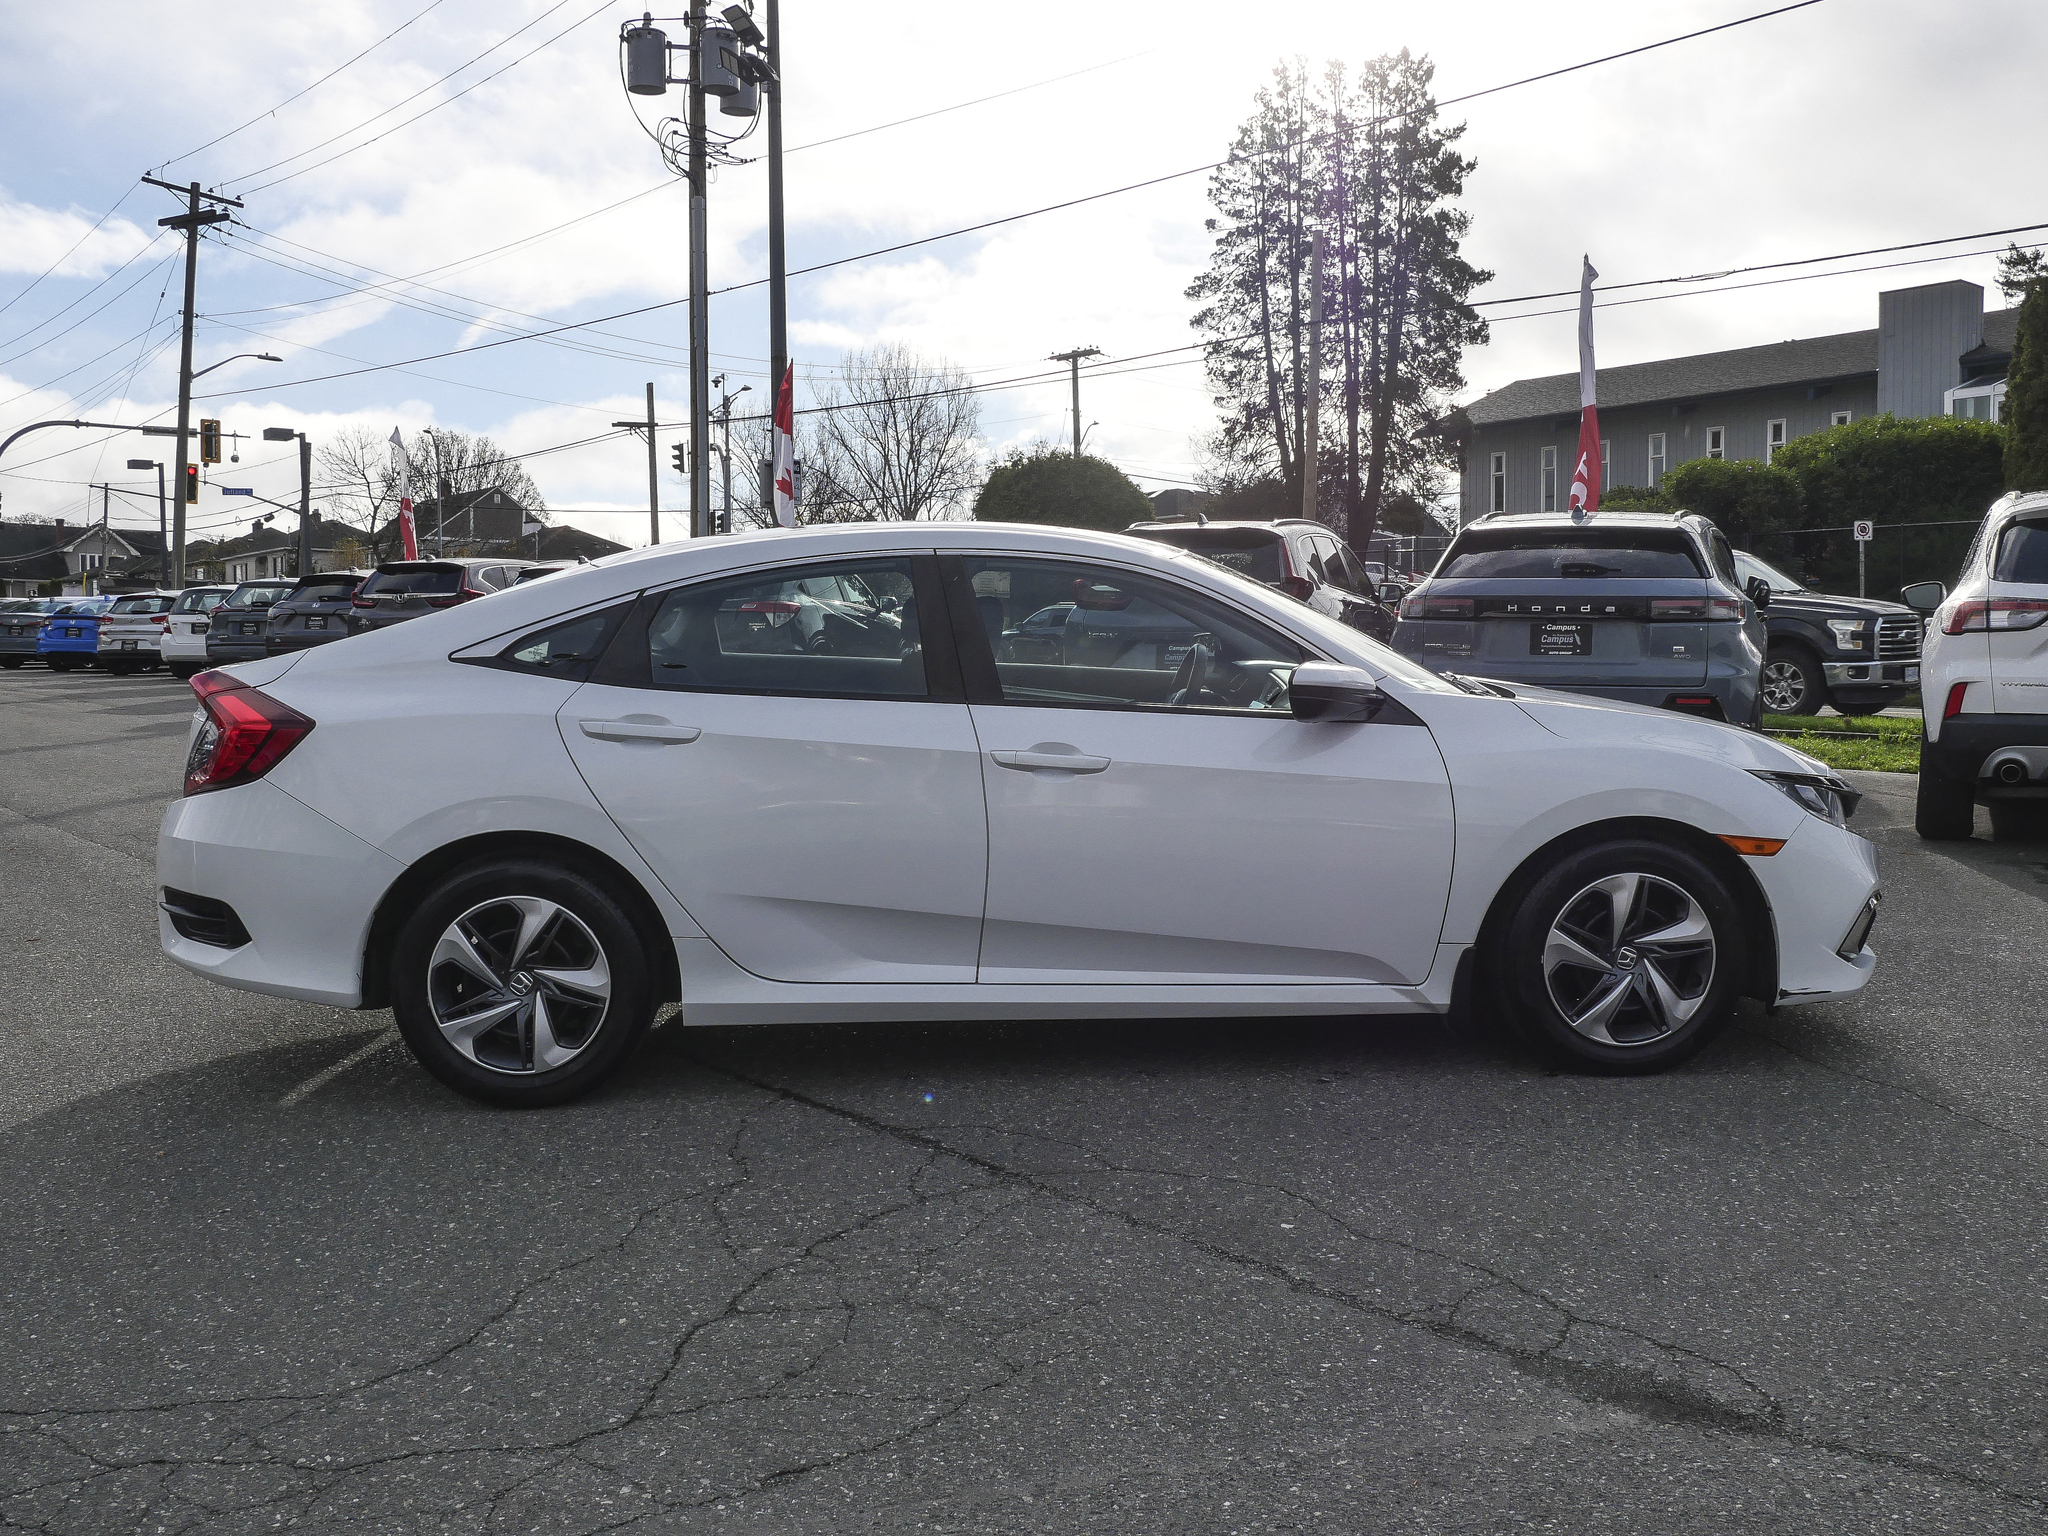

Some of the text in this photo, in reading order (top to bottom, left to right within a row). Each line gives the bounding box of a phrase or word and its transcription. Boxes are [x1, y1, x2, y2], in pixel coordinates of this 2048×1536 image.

[1507, 604, 1616, 613] Honda
[1546, 624, 1577, 632] Campus
[1541, 634, 1574, 645] Campus
